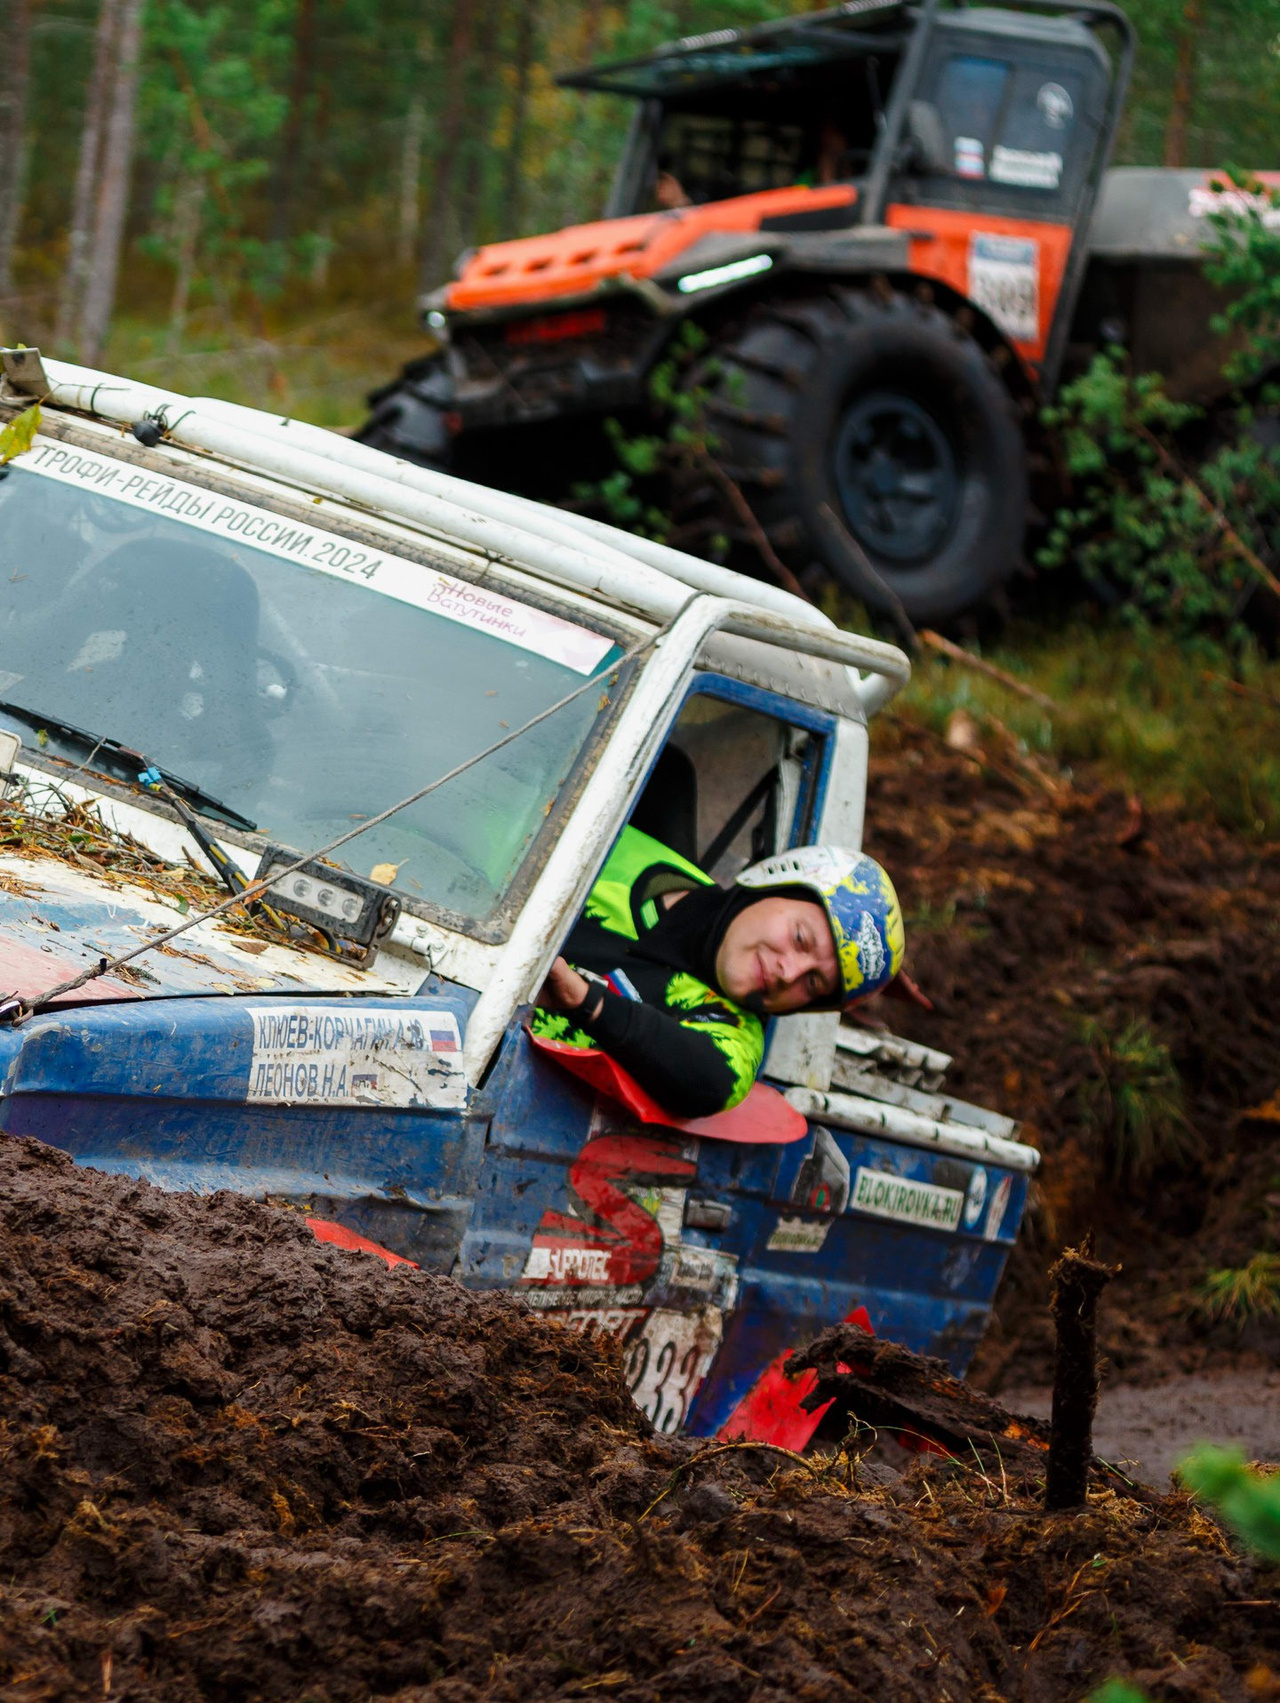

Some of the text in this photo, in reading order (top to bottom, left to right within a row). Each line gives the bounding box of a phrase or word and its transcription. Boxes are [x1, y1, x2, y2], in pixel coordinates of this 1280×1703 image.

[33, 444, 216, 520] ТРОФИ-РЕЙДЫ
[426, 585, 527, 637] Ватутинки
[441, 582, 514, 618] Новые
[252, 1062, 349, 1098] ЛЕОНОВ Н.А.
